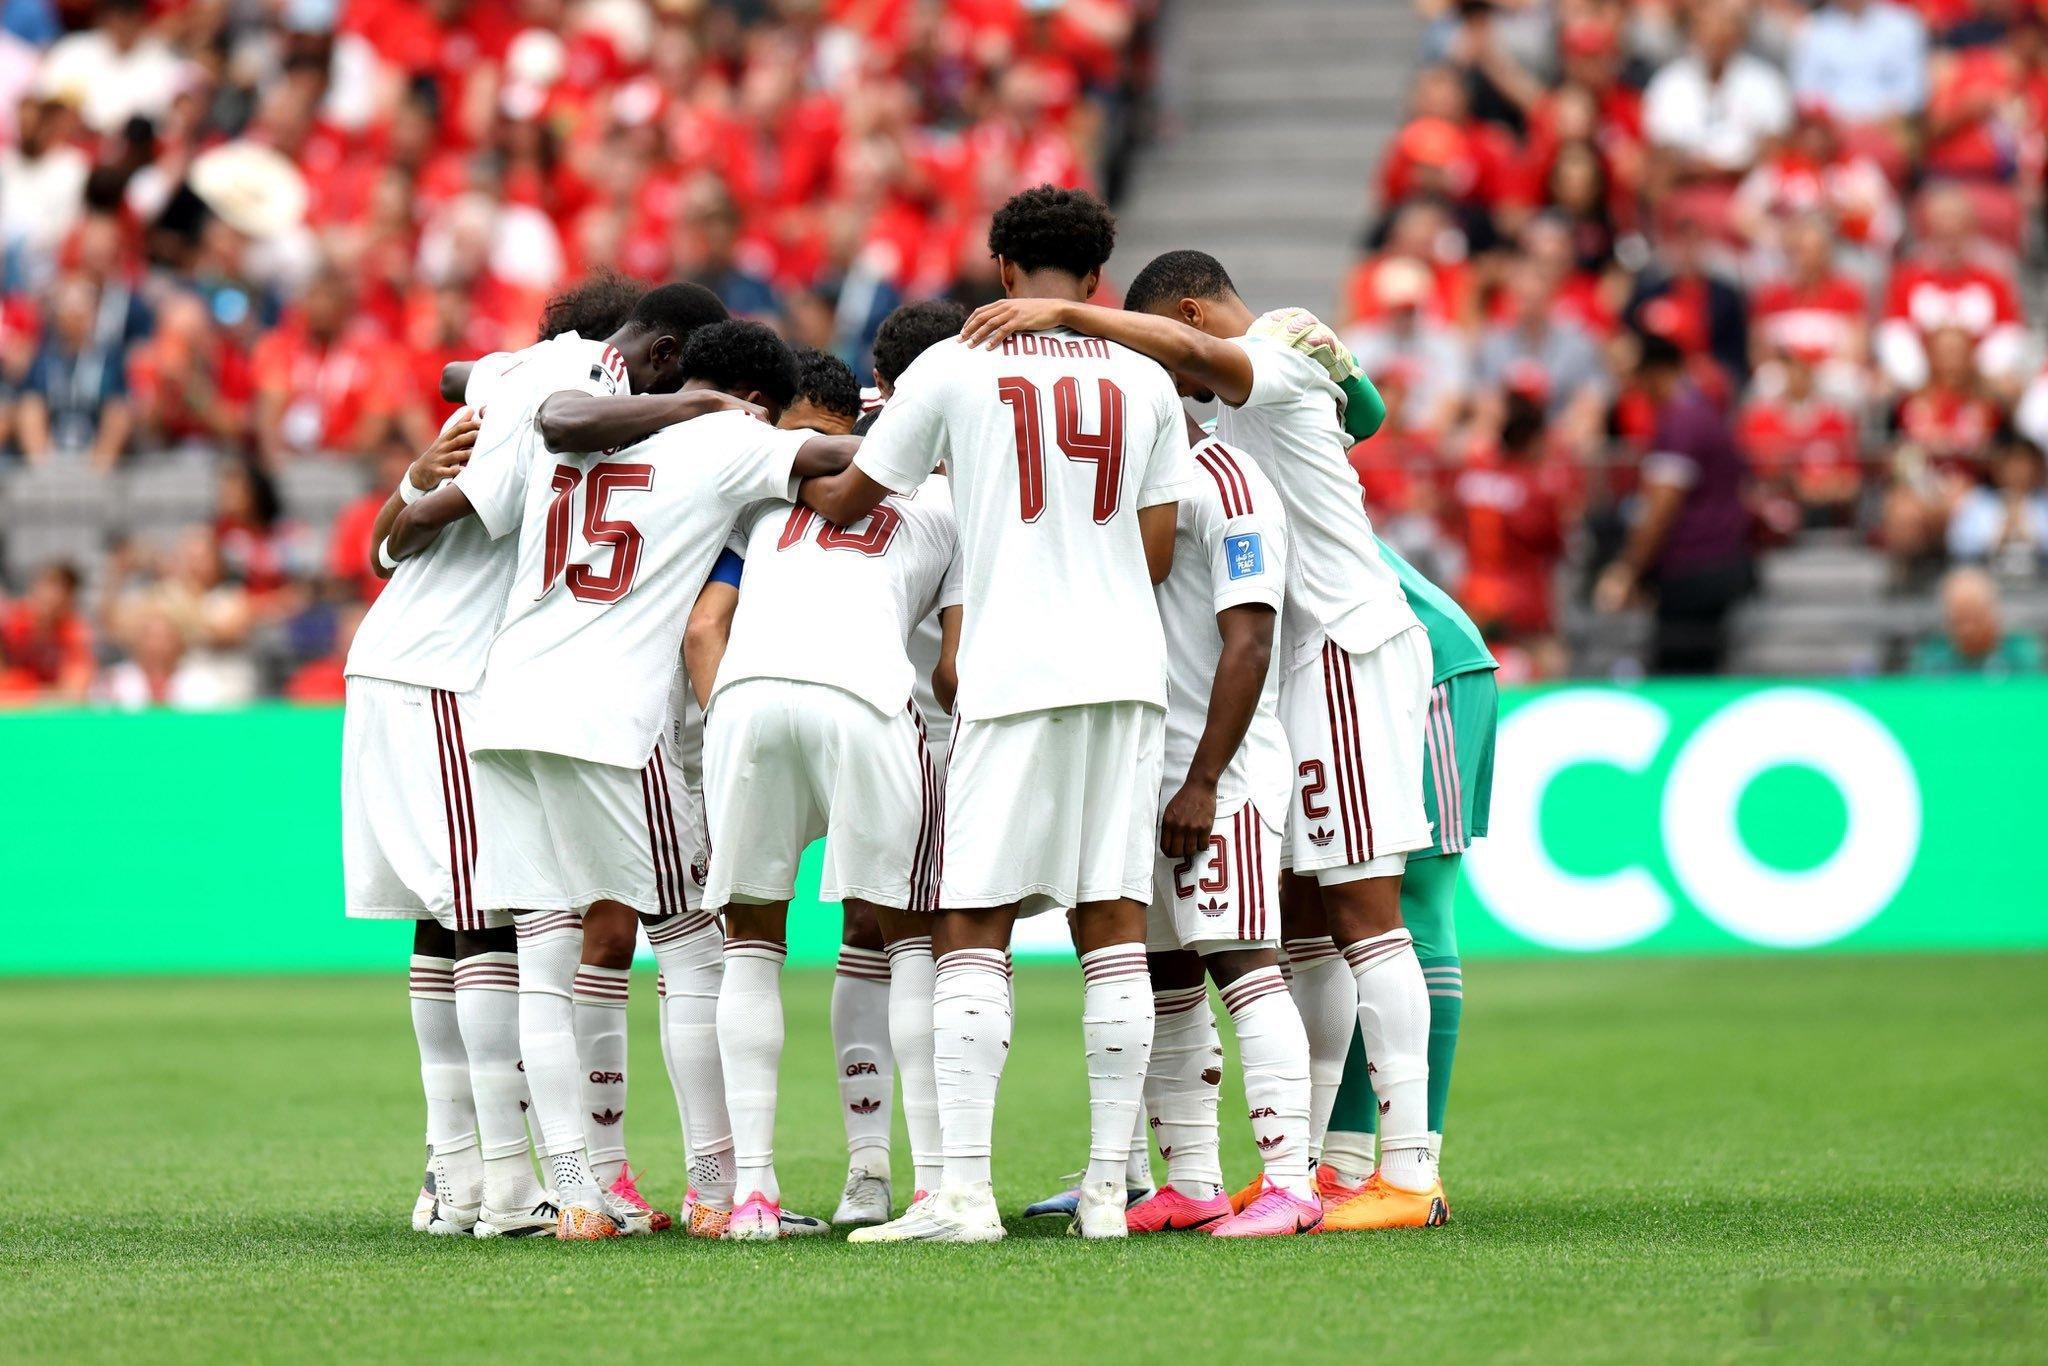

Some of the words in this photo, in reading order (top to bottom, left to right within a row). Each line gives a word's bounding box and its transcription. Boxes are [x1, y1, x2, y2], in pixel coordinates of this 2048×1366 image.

[1002, 332, 1110, 360] HOMAM
[998, 376, 1126, 525] 14
[534, 463, 655, 606] 15
[1236, 558, 1254, 570] PEACE
[1298, 758, 1331, 821] 2
[1173, 834, 1230, 900] 23
[589, 1071, 624, 1084] QFA
[846, 1062, 879, 1077] QFA
[1150, 1117, 1163, 1129] FA
